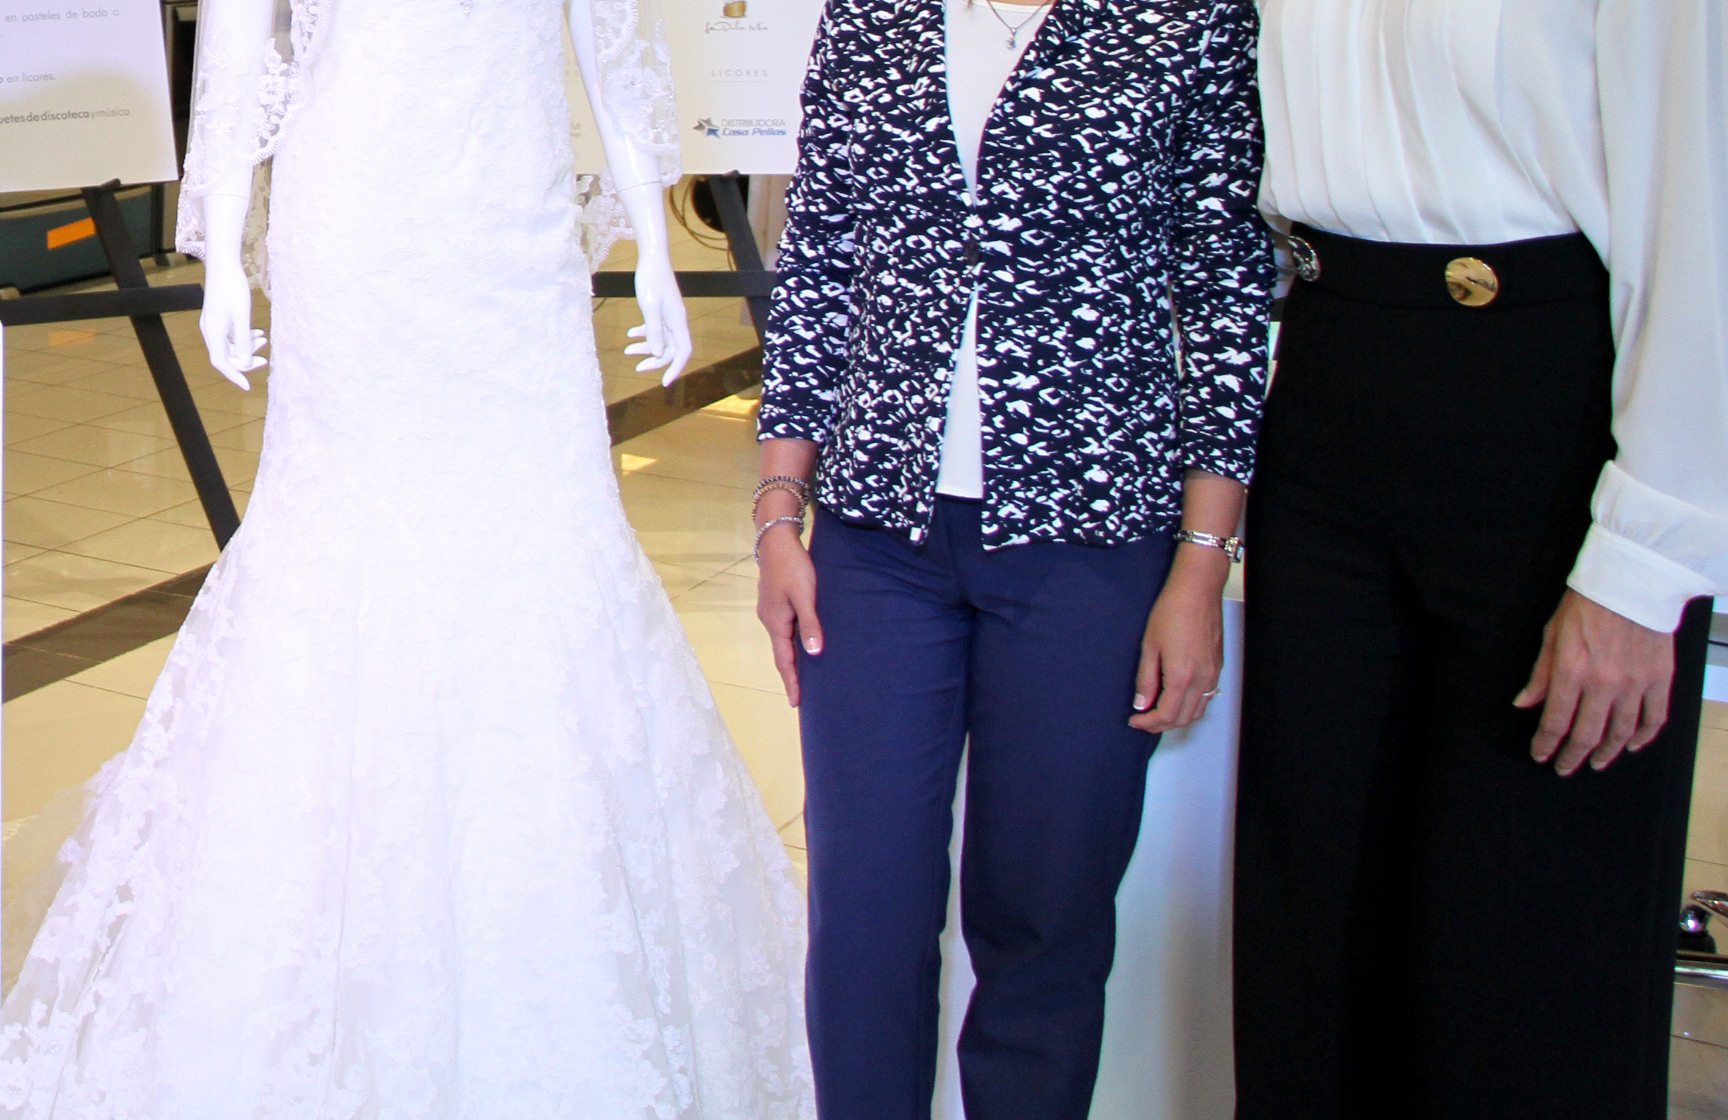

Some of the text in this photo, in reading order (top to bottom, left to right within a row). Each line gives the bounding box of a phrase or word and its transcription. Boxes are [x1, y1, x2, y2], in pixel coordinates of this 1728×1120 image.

[4, 15, 17, 23] en
[21, 9, 61, 23] pasteles
[64, 9, 78, 19] de
[710, 68, 769, 77] LICORES
[6, 74, 19, 83] en
[26, 111, 44, 123] de
[41, 109, 90, 121] discoteca
[721, 118, 786, 127] DISTRIBUIDORA
[722, 128, 749, 136] Casa
